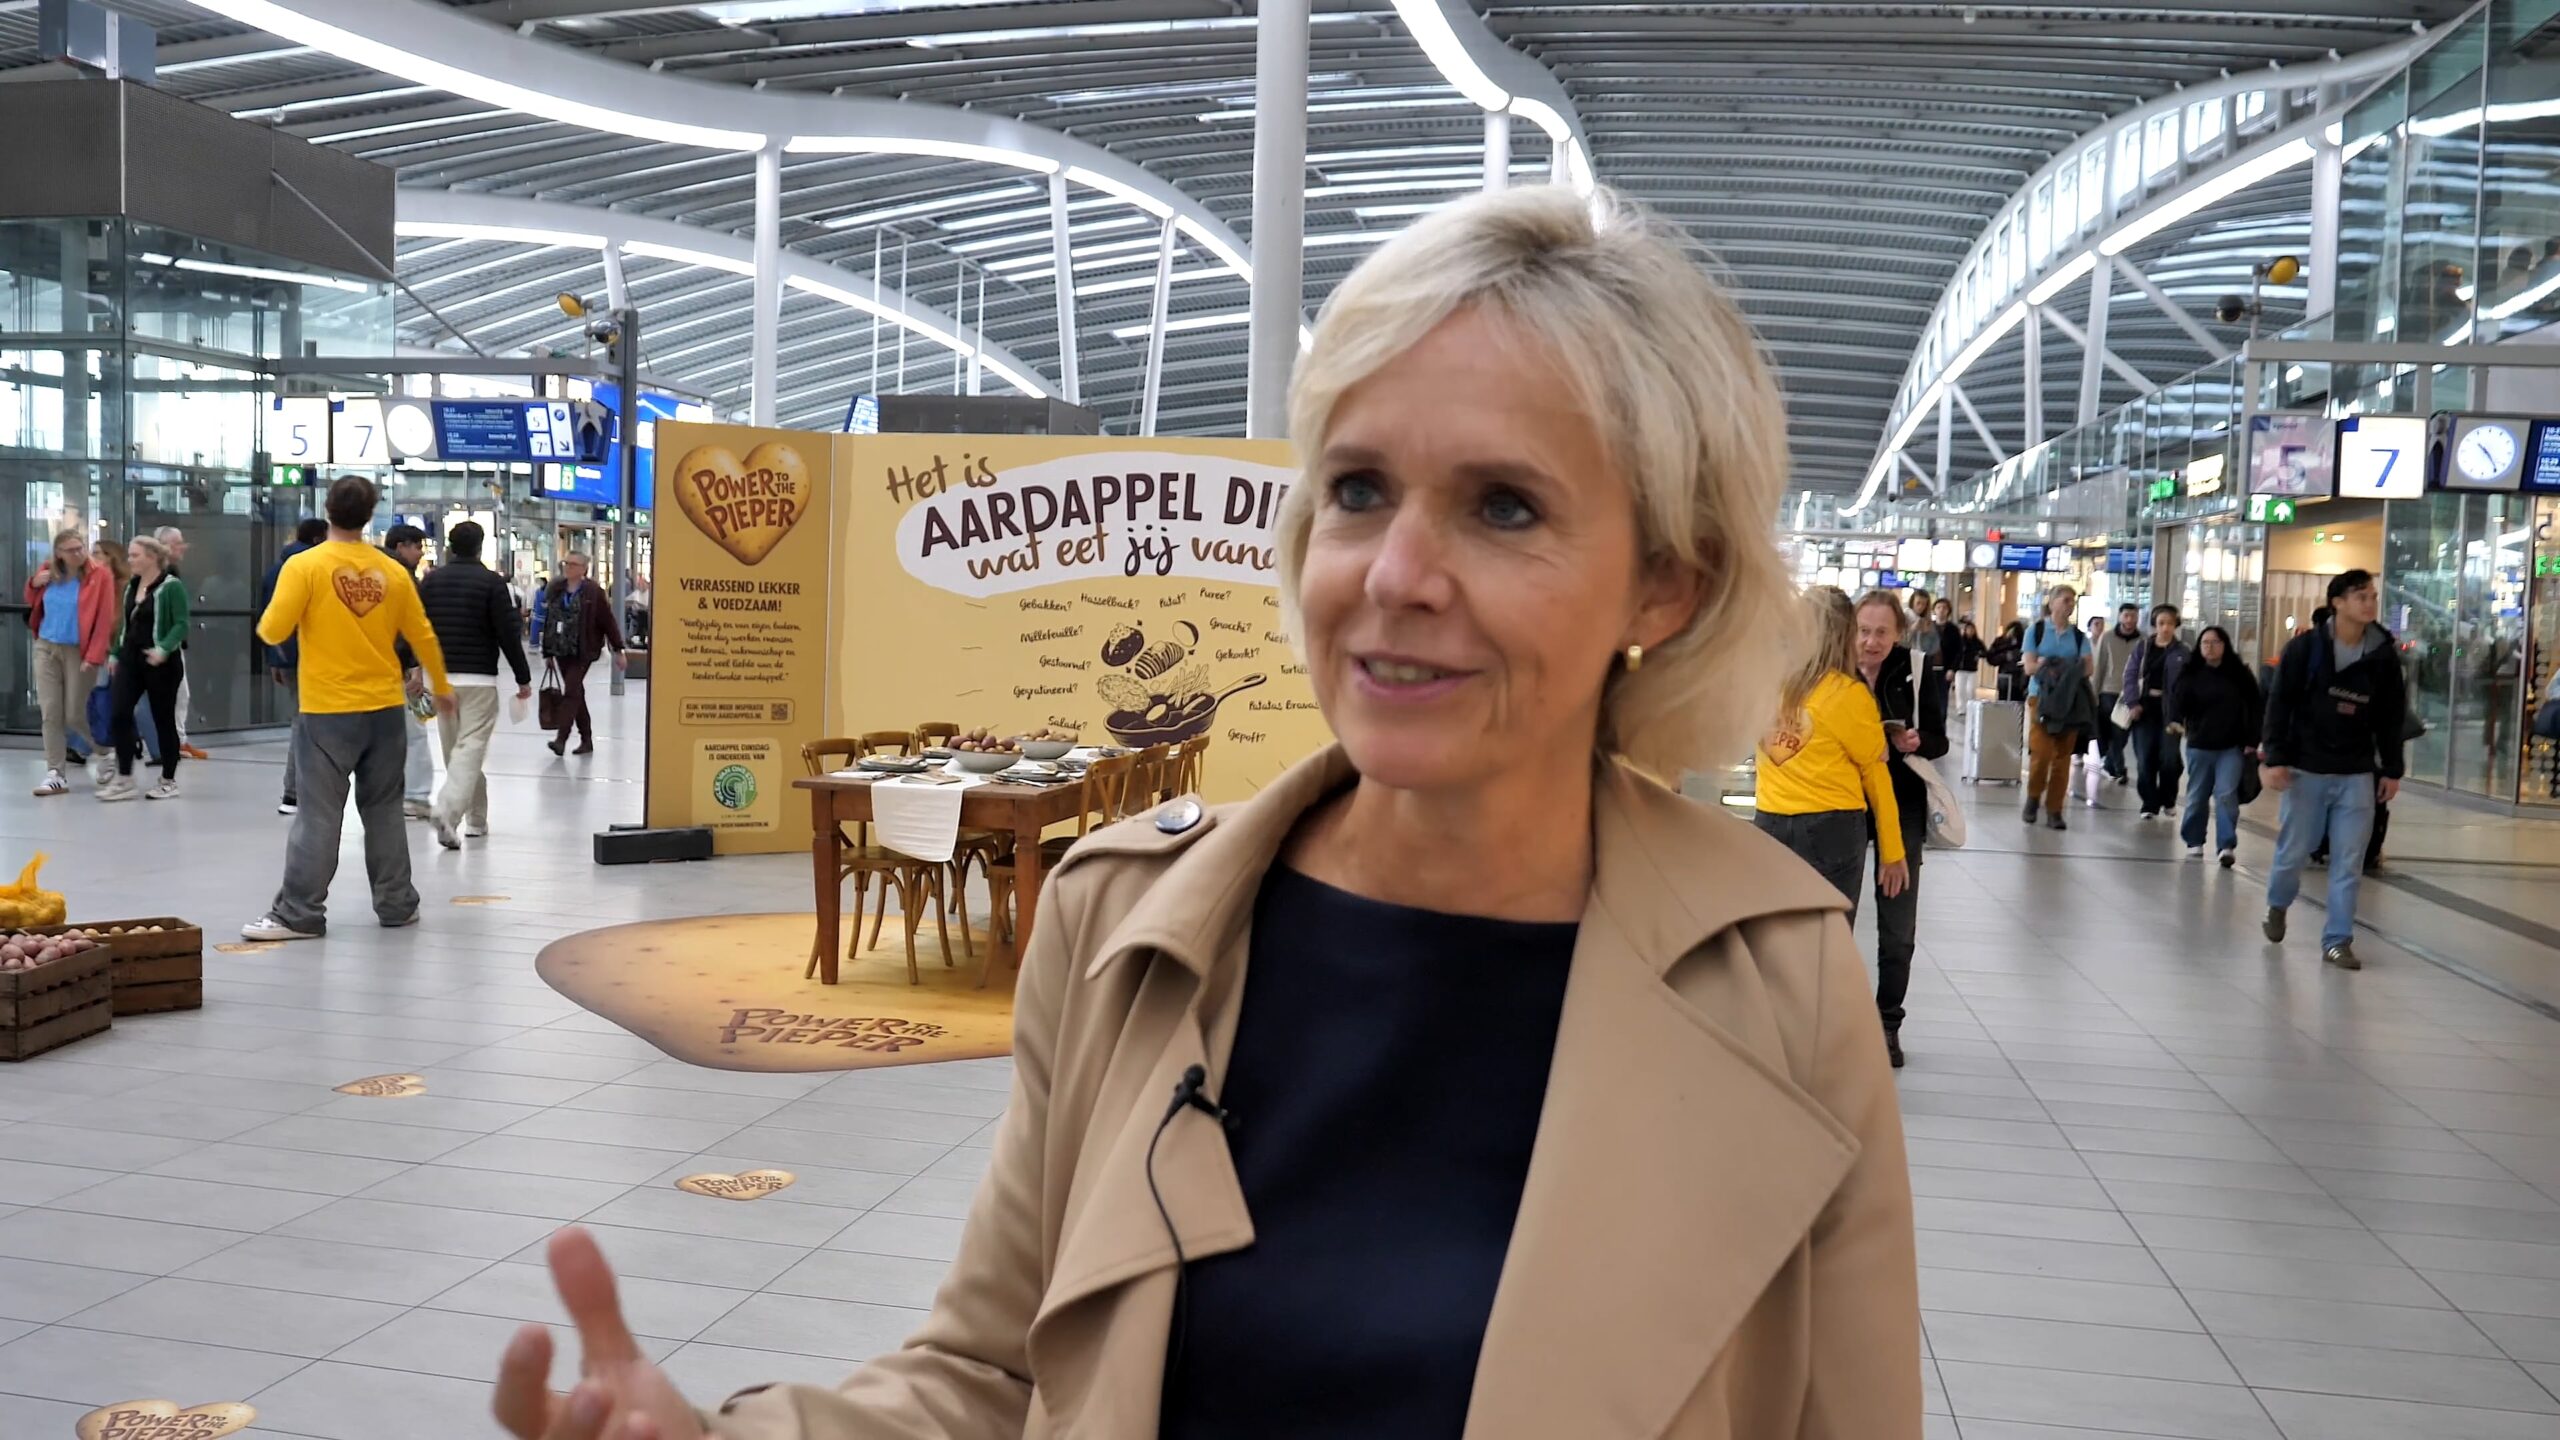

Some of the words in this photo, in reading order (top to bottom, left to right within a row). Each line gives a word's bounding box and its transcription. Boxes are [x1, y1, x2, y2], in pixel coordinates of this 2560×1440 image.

[291, 424, 308, 456] 5
[353, 425, 373, 458] 7
[2277, 444, 2307, 490] 5
[2370, 449, 2400, 488] 7
[775, 472, 789, 482] TO
[886, 454, 949, 504] Het
[963, 453, 997, 488] is
[692, 468, 778, 508] POWER
[775, 482, 796, 495] THE
[705, 498, 796, 540] PIEPER
[921, 472, 1203, 558] AARDAPPEL
[967, 530, 1042, 580] wat
[1056, 522, 1109, 567] eet
[1124, 525, 1180, 577] jij
[680, 577, 754, 594] VERRASSEND
[758, 581, 801, 595] LEKKER
[1200, 587, 1232, 600] Puree?
[697, 597, 708, 610] &
[712, 597, 782, 612] VOEDZAAM!
[1019, 598, 1072, 611] Gebakken?
[1080, 592, 1140, 610] Hasselback?
[1159, 592, 1186, 608] Patat?
[1210, 616, 1252, 633] Gnocchi?
[1020, 624, 1083, 643] Millefeuille?
[1215, 647, 1260, 661] Gekookt?
[1039, 655, 1091, 671] Gestoomd?
[1013, 683, 1078, 700] Gegratineerd?
[1249, 700, 1282, 711] Patatas
[1286, 699, 1320, 710] Bravas
[1048, 715, 1088, 731] Salade?
[1228, 728, 1266, 743] Gepoft?
[729, 1008, 909, 1034] POWER
[914, 1022, 942, 1030] TO
[719, 1026, 924, 1052] PIEPER
[901, 1028, 947, 1038] THE
[690, 1176, 762, 1188] POWER
[704, 1182, 783, 1196] PIEPER
[105, 1410, 209, 1429] POWER
[202, 1421, 228, 1429] THE
[100, 1427, 213, 1440] PIEPER
